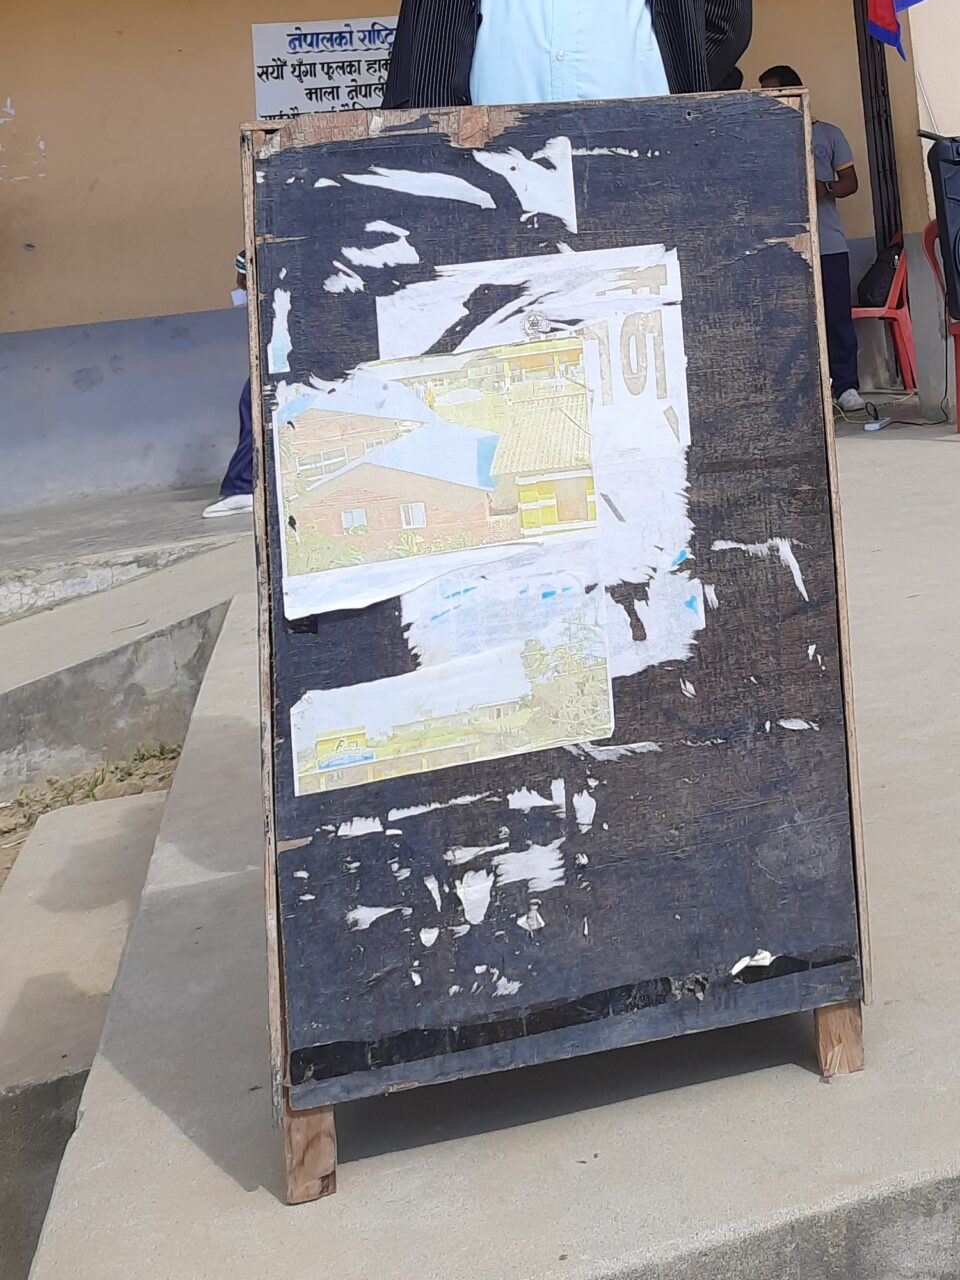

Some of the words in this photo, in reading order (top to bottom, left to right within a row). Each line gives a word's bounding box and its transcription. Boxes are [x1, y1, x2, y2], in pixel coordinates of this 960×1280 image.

[287, 22, 353, 51] नेपालको
[357, 21, 398, 50] राष्ट्रि
[304, 85, 340, 103] माला
